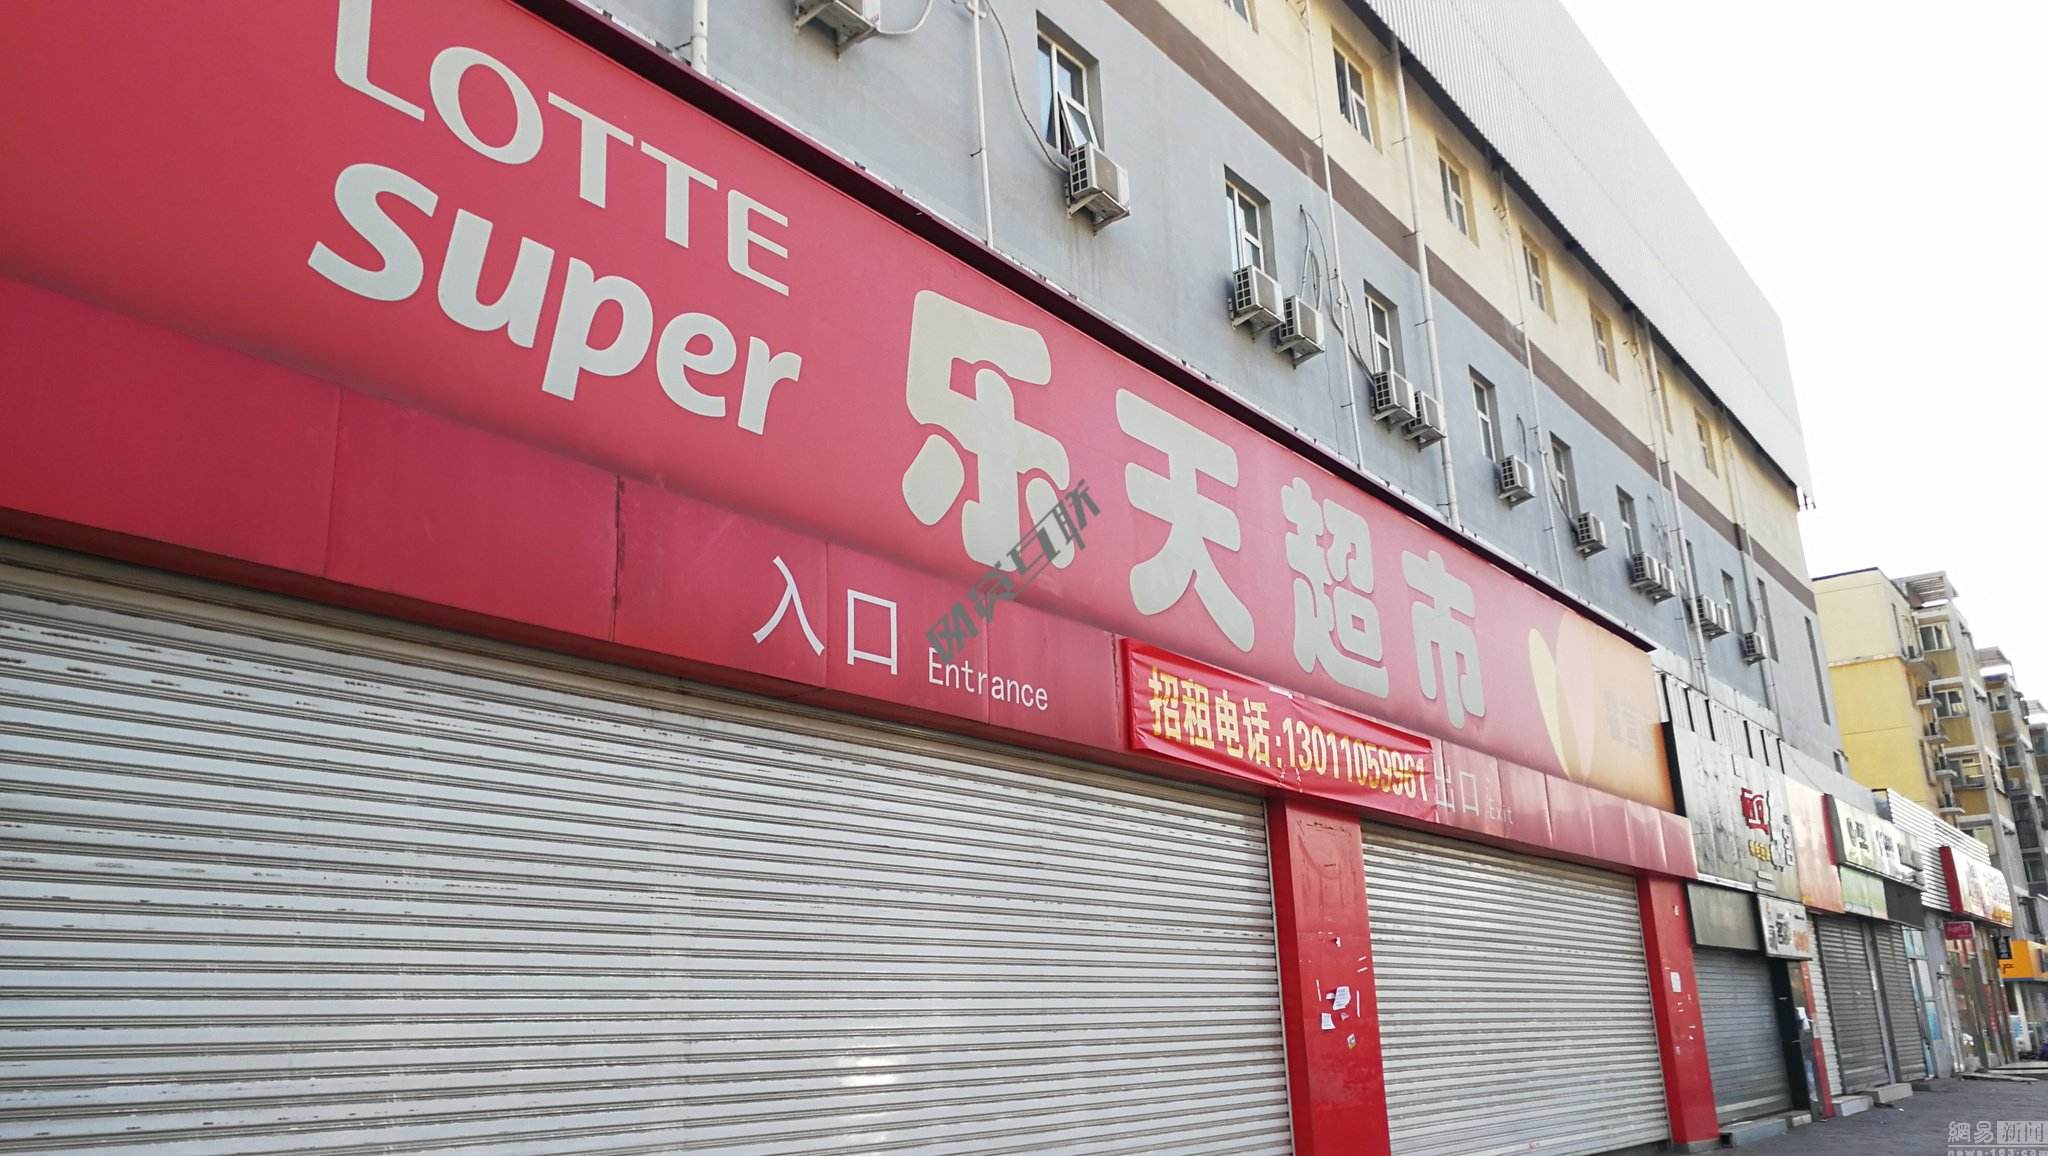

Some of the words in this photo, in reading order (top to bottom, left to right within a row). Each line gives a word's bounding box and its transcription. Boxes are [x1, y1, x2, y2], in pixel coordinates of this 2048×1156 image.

[334, 0, 789, 296] LOTTE
[902, 290, 1485, 728] 乐天超市
[752, 555, 898, 675] 入口
[928, 647, 1048, 710] Entrance
[1433, 749, 1479, 816] 出口
